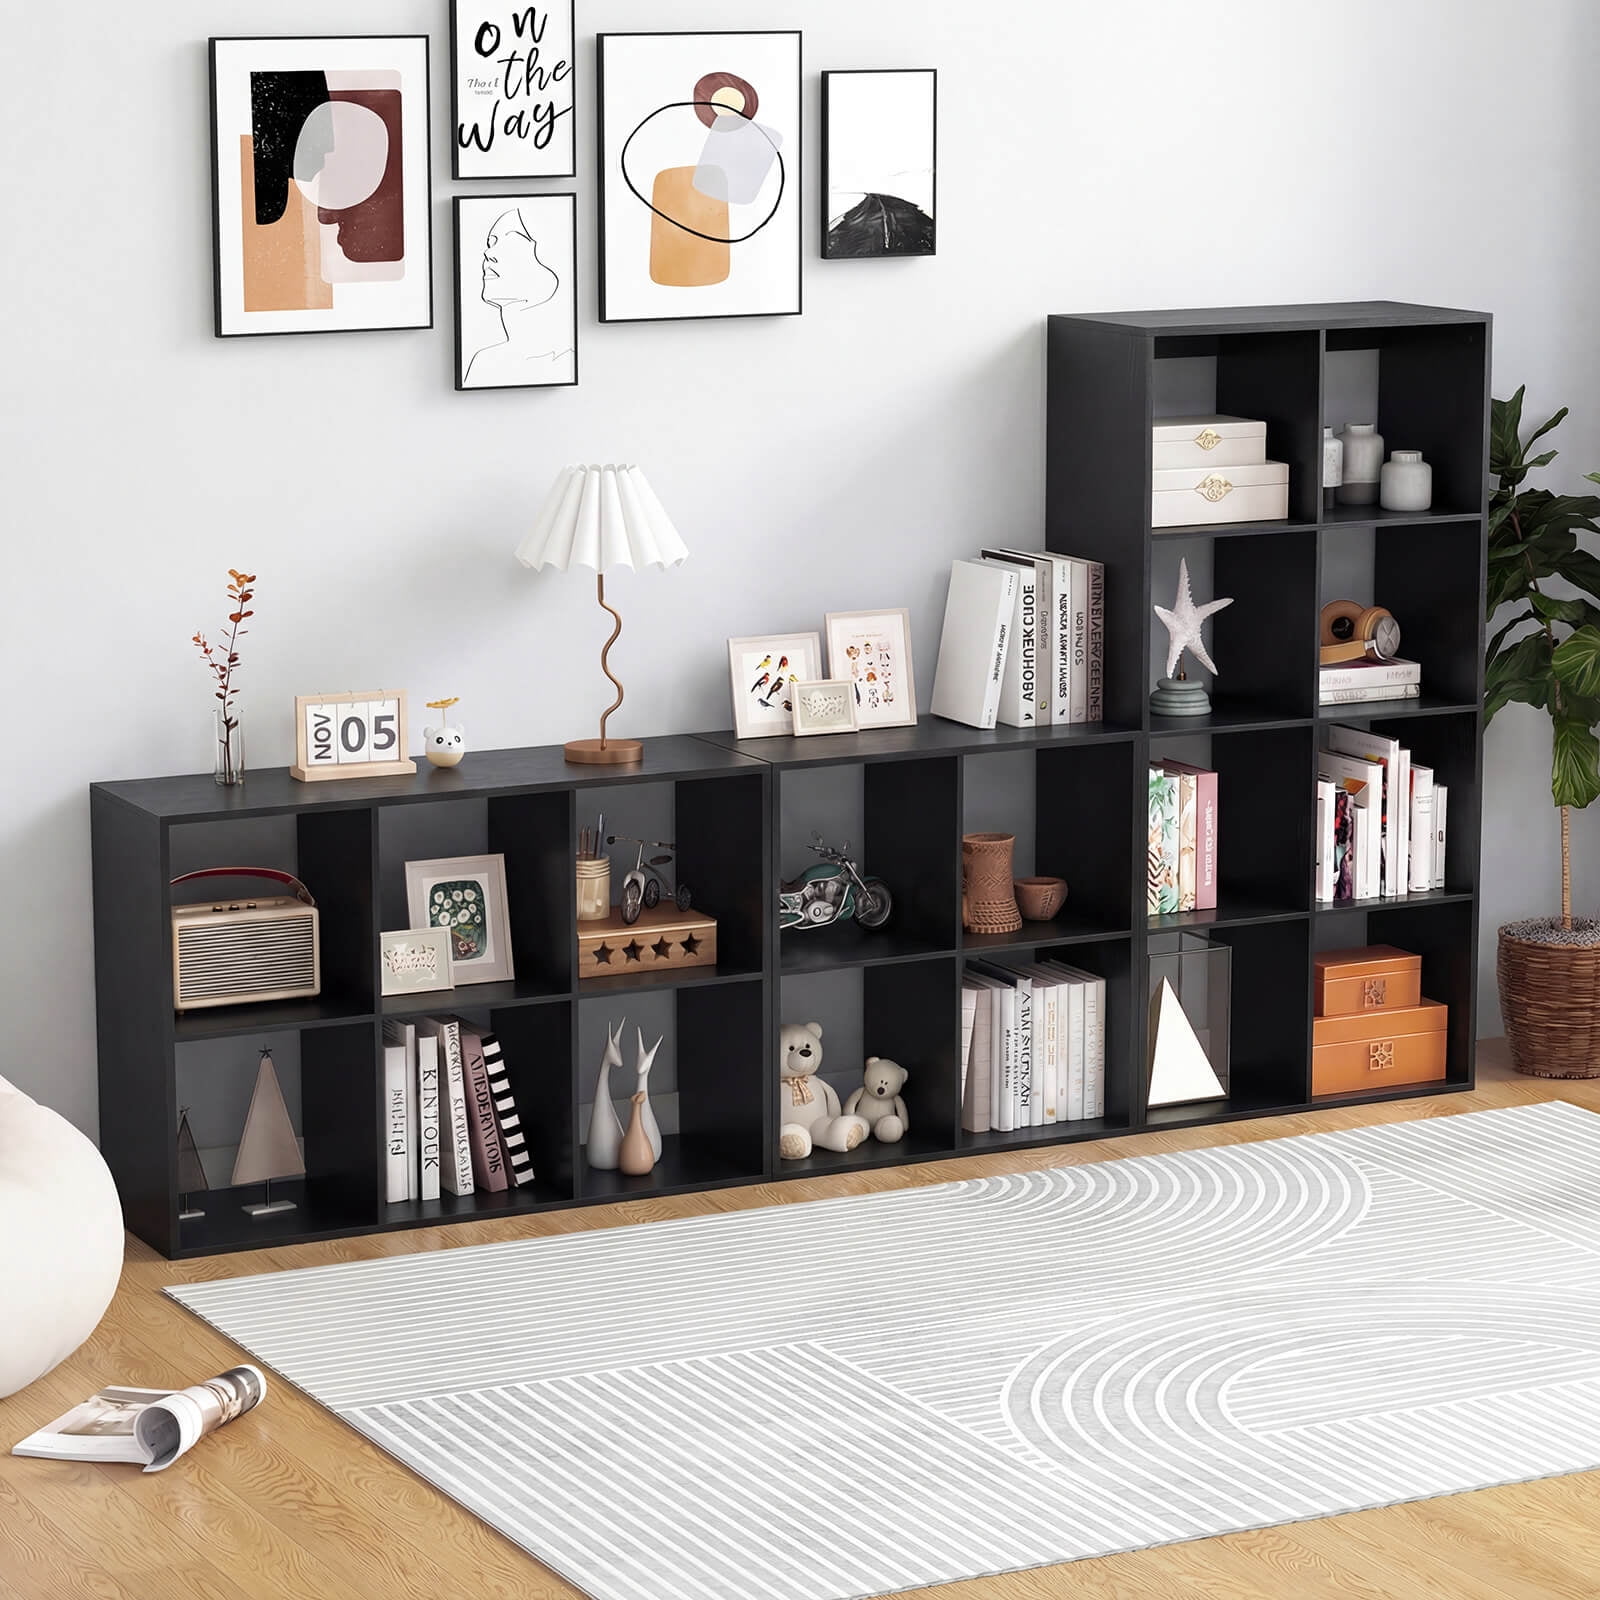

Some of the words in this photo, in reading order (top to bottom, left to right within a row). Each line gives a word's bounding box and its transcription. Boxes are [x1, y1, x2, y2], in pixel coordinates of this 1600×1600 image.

[497, 47, 572, 100] the
[313, 713, 332, 760] NOV
[340, 714, 396, 753] 05
